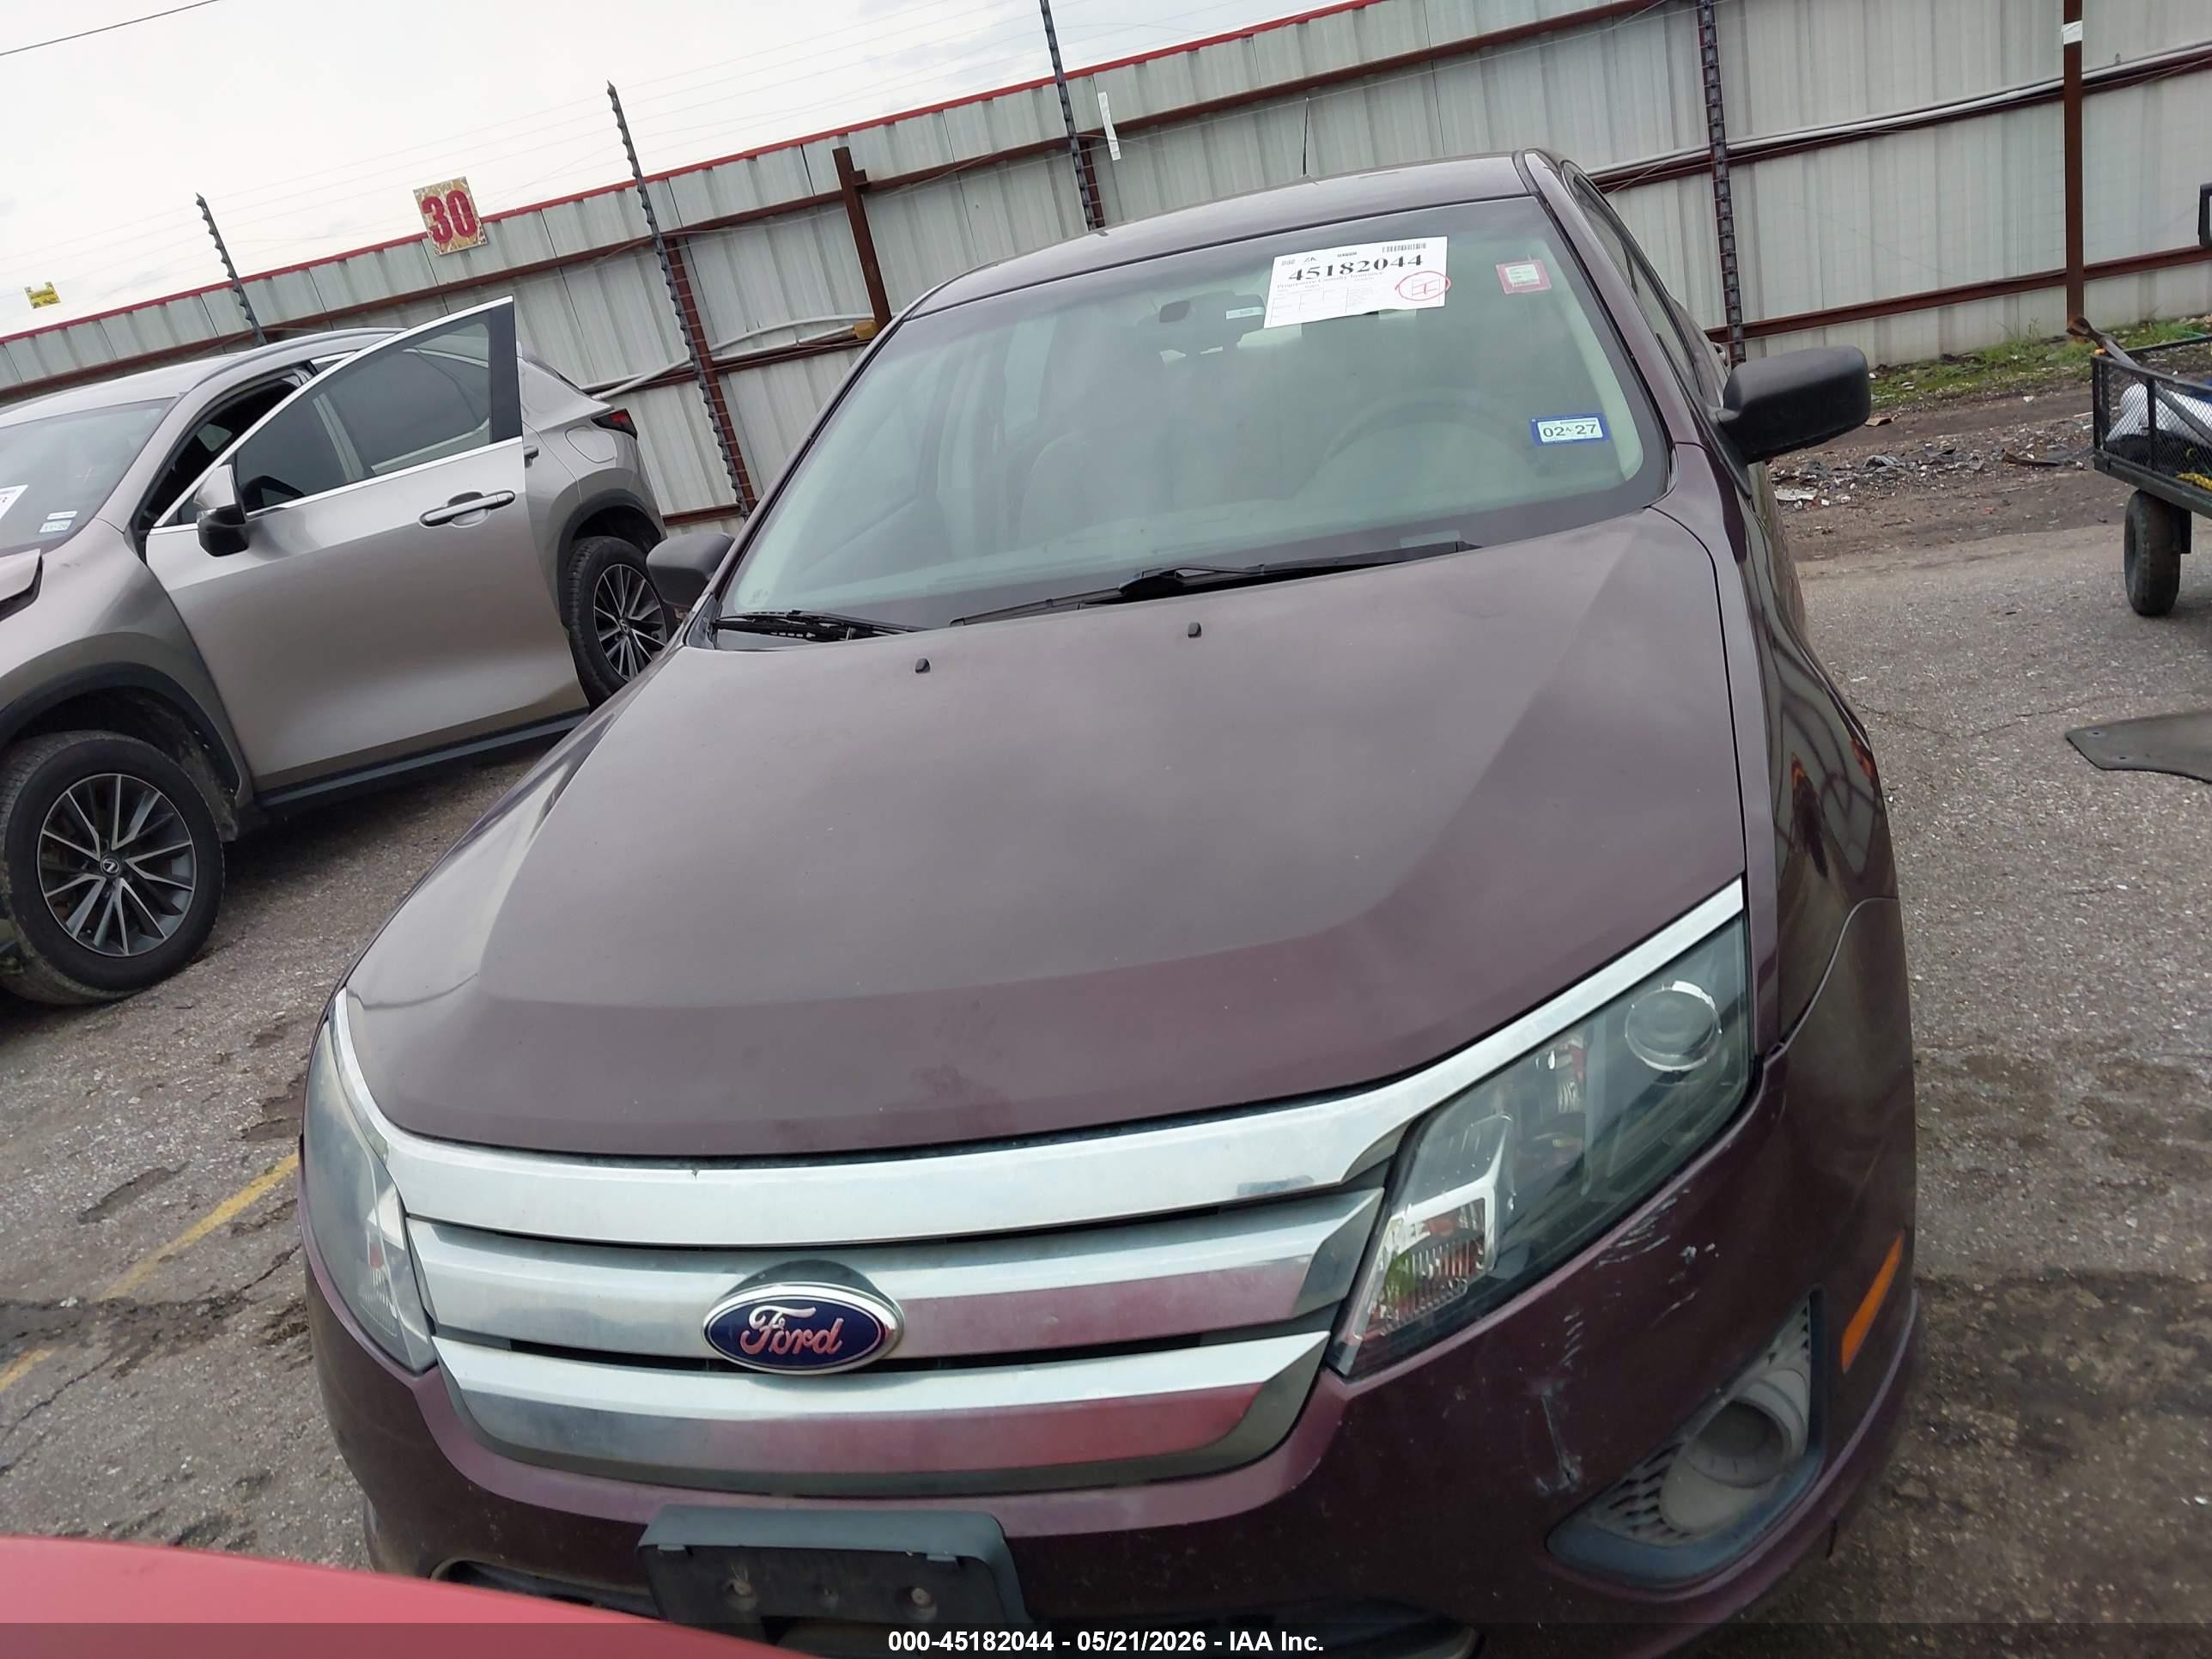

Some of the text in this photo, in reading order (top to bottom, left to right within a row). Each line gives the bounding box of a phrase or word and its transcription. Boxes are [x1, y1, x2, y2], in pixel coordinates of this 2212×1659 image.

[422, 191, 477, 244] 30
[1288, 254, 1423, 282] 45182044
[740, 1304, 844, 1355] Ford
